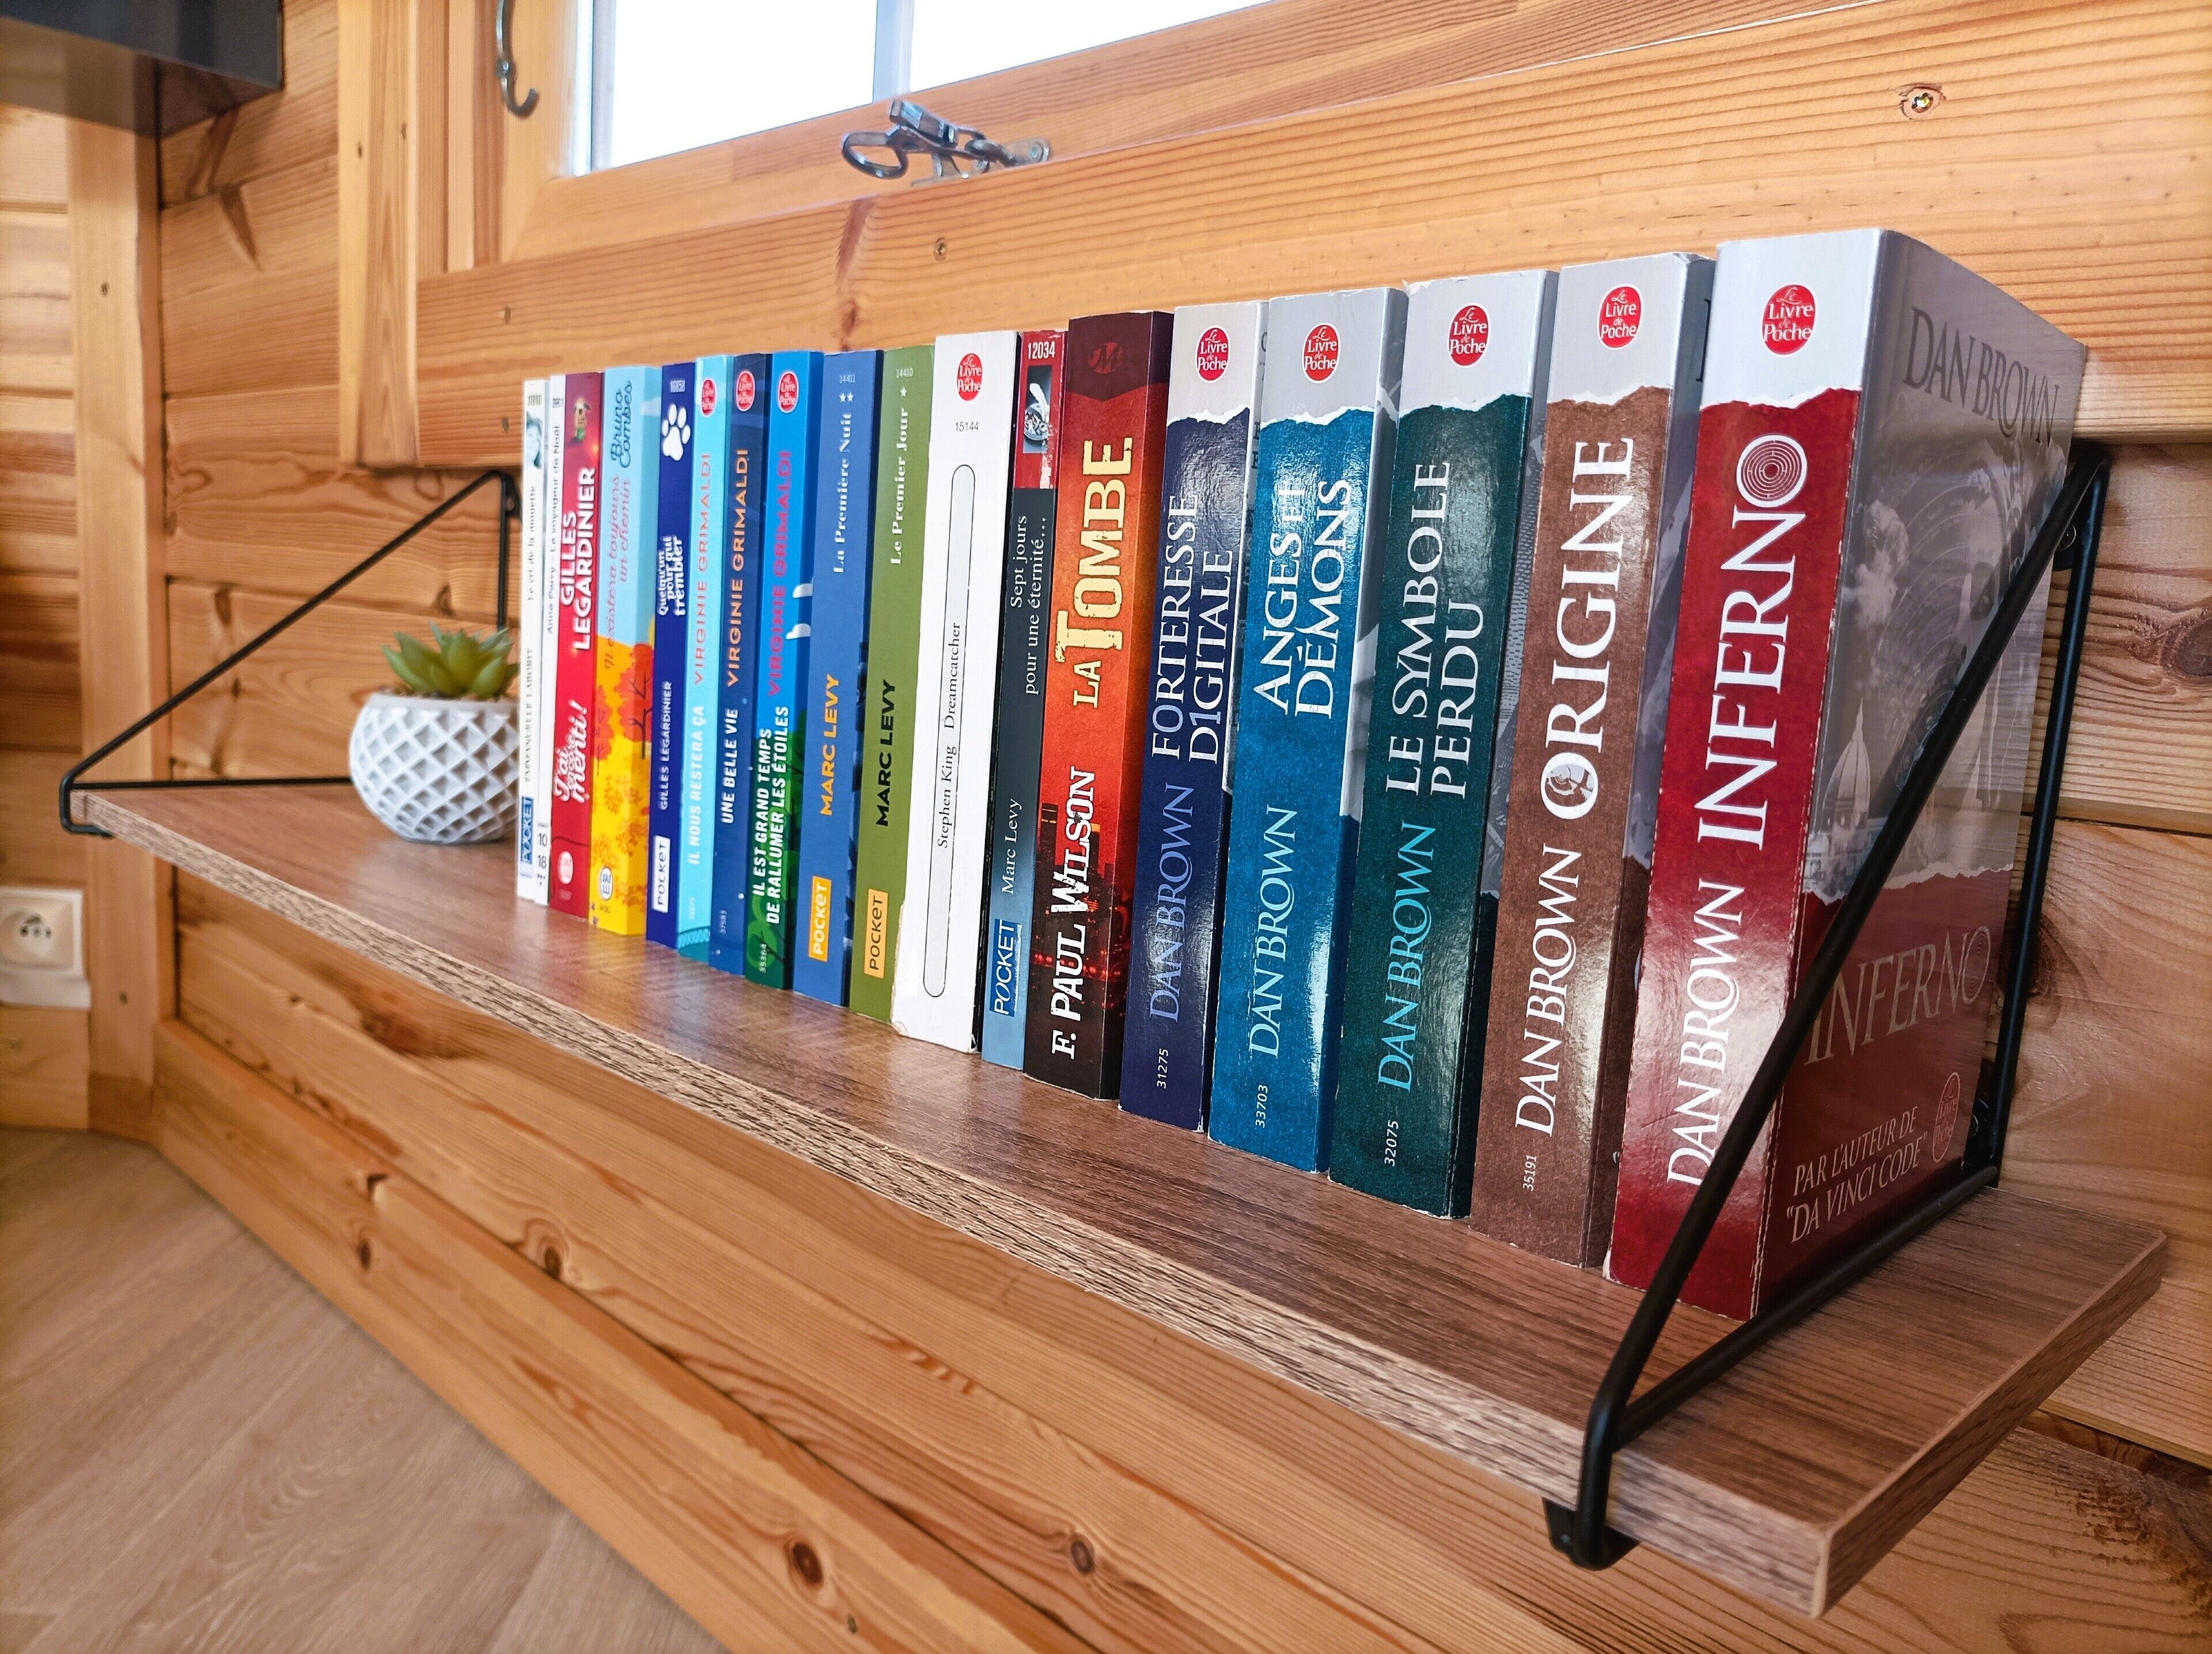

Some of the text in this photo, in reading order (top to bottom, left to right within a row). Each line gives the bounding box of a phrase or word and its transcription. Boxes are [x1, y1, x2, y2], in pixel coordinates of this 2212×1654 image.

[1453, 320, 1488, 336] Livre
[1459, 307, 1479, 323] Le
[1600, 324, 1637, 339] Poche
[1605, 301, 1637, 318] Livre
[1611, 290, 1627, 304] Le
[1613, 317, 1624, 327] de
[1767, 302, 1814, 321] Livre
[1777, 286, 1801, 305] Le
[1778, 317, 1791, 328] de
[963, 354, 977, 367] Le
[1028, 341, 1056, 359] 12034
[1197, 356, 1228, 373] Poche
[1200, 341, 1228, 355] Livre
[1206, 352, 1215, 361] de
[1207, 329, 1221, 344] Le
[1304, 355, 1337, 371] Poche
[1307, 339, 1338, 354] Livre
[1314, 326, 1330, 342] Le
[1314, 351, 1323, 361] de
[1450, 337, 1486, 355] Poche
[1460, 332, 1471, 343] de
[1763, 323, 1812, 344] Poche
[839, 374, 856, 384] 14411
[896, 367, 914, 378] 14410
[957, 378, 982, 393] Poche
[959, 365, 982, 377] Livre
[1904, 306, 2061, 447] DAN BROWN
[609, 388, 624, 461] Bruno
[619, 380, 632, 468] Combes
[955, 422, 979, 432] 15144
[608, 475, 621, 559] toujours
[833, 412, 852, 573] La Première Nuit
[891, 407, 908, 564] Le Premier Jour
[560, 511, 577, 606] GILLES
[573, 467, 596, 651] LEGARDINIER
[619, 476, 630, 583] un chemin
[1010, 515, 1028, 608] Sept jours
[657, 550, 669, 616] Quelqu'un
[663, 536, 676, 600] pour qui
[672, 534, 686, 616] trembler
[694, 453, 711, 685] VIRGINIE GRIMALDI
[728, 450, 748, 687] VIRGINIE GRIMALDI
[768, 450, 793, 697] VIRGINIE GRIMALDI
[1054, 437, 1134, 709] LA TOMBE
[1253, 480, 1305, 716] ANGES ET
[1294, 479, 1351, 720] DÉMONS
[608, 564, 616, 647] existera
[1028, 614, 1040, 647] une
[1152, 494, 1199, 760] FORTERESSE
[1385, 461, 1452, 796] LE SYMBOLE
[1540, 438, 1634, 820] ORIGINE
[1025, 653, 1039, 696] pour
[1694, 434, 1808, 851] INFERNO
[1430, 597, 1484, 800] PERDU
[566, 733, 577, 791] encore
[657, 681, 672, 810] GILLES LEGARDINIER
[721, 708, 739, 824] UNE BELLE VIE
[820, 673, 840, 816] MARC LEVY
[876, 679, 896, 826] MARC LEVY
[937, 622, 961, 849] Stephen King Dreamcatcher
[553, 748, 570, 802] J'ai
[688, 706, 706, 866] IL NOUS RESTERA ÇA
[521, 795, 533, 864] POCKET
[752, 728, 772, 897] IL EST GRAND TEMPS
[765, 706, 789, 924] DE RALLUMER LES ÉTOILES
[1001, 798, 1022, 895] Marc Levy
[1050, 766, 1095, 1060] F. PAUL WILSON
[1150, 782, 1195, 1023] DAN BROWN
[1249, 804, 1298, 1059] DAN BROWN
[994, 919, 1014, 1015] POCKET
[1378, 820, 1436, 1094] DAN BROWN
[1514, 843, 1582, 1137] DAN BROWN
[1156, 1048, 1169, 1089] 31275
[1666, 878, 1745, 1186] DAN BROWN
[1255, 1084, 1268, 1129] 33703
[1384, 1120, 1399, 1167] 32075
[1522, 1154, 1537, 1192] 35191
[1793, 1155, 1828, 1197] PAR
[1831, 1117, 1896, 1179] L'AUTEUR
[1899, 1106, 1918, 1139] DE
[1827, 1162, 1877, 1222] VINCI
